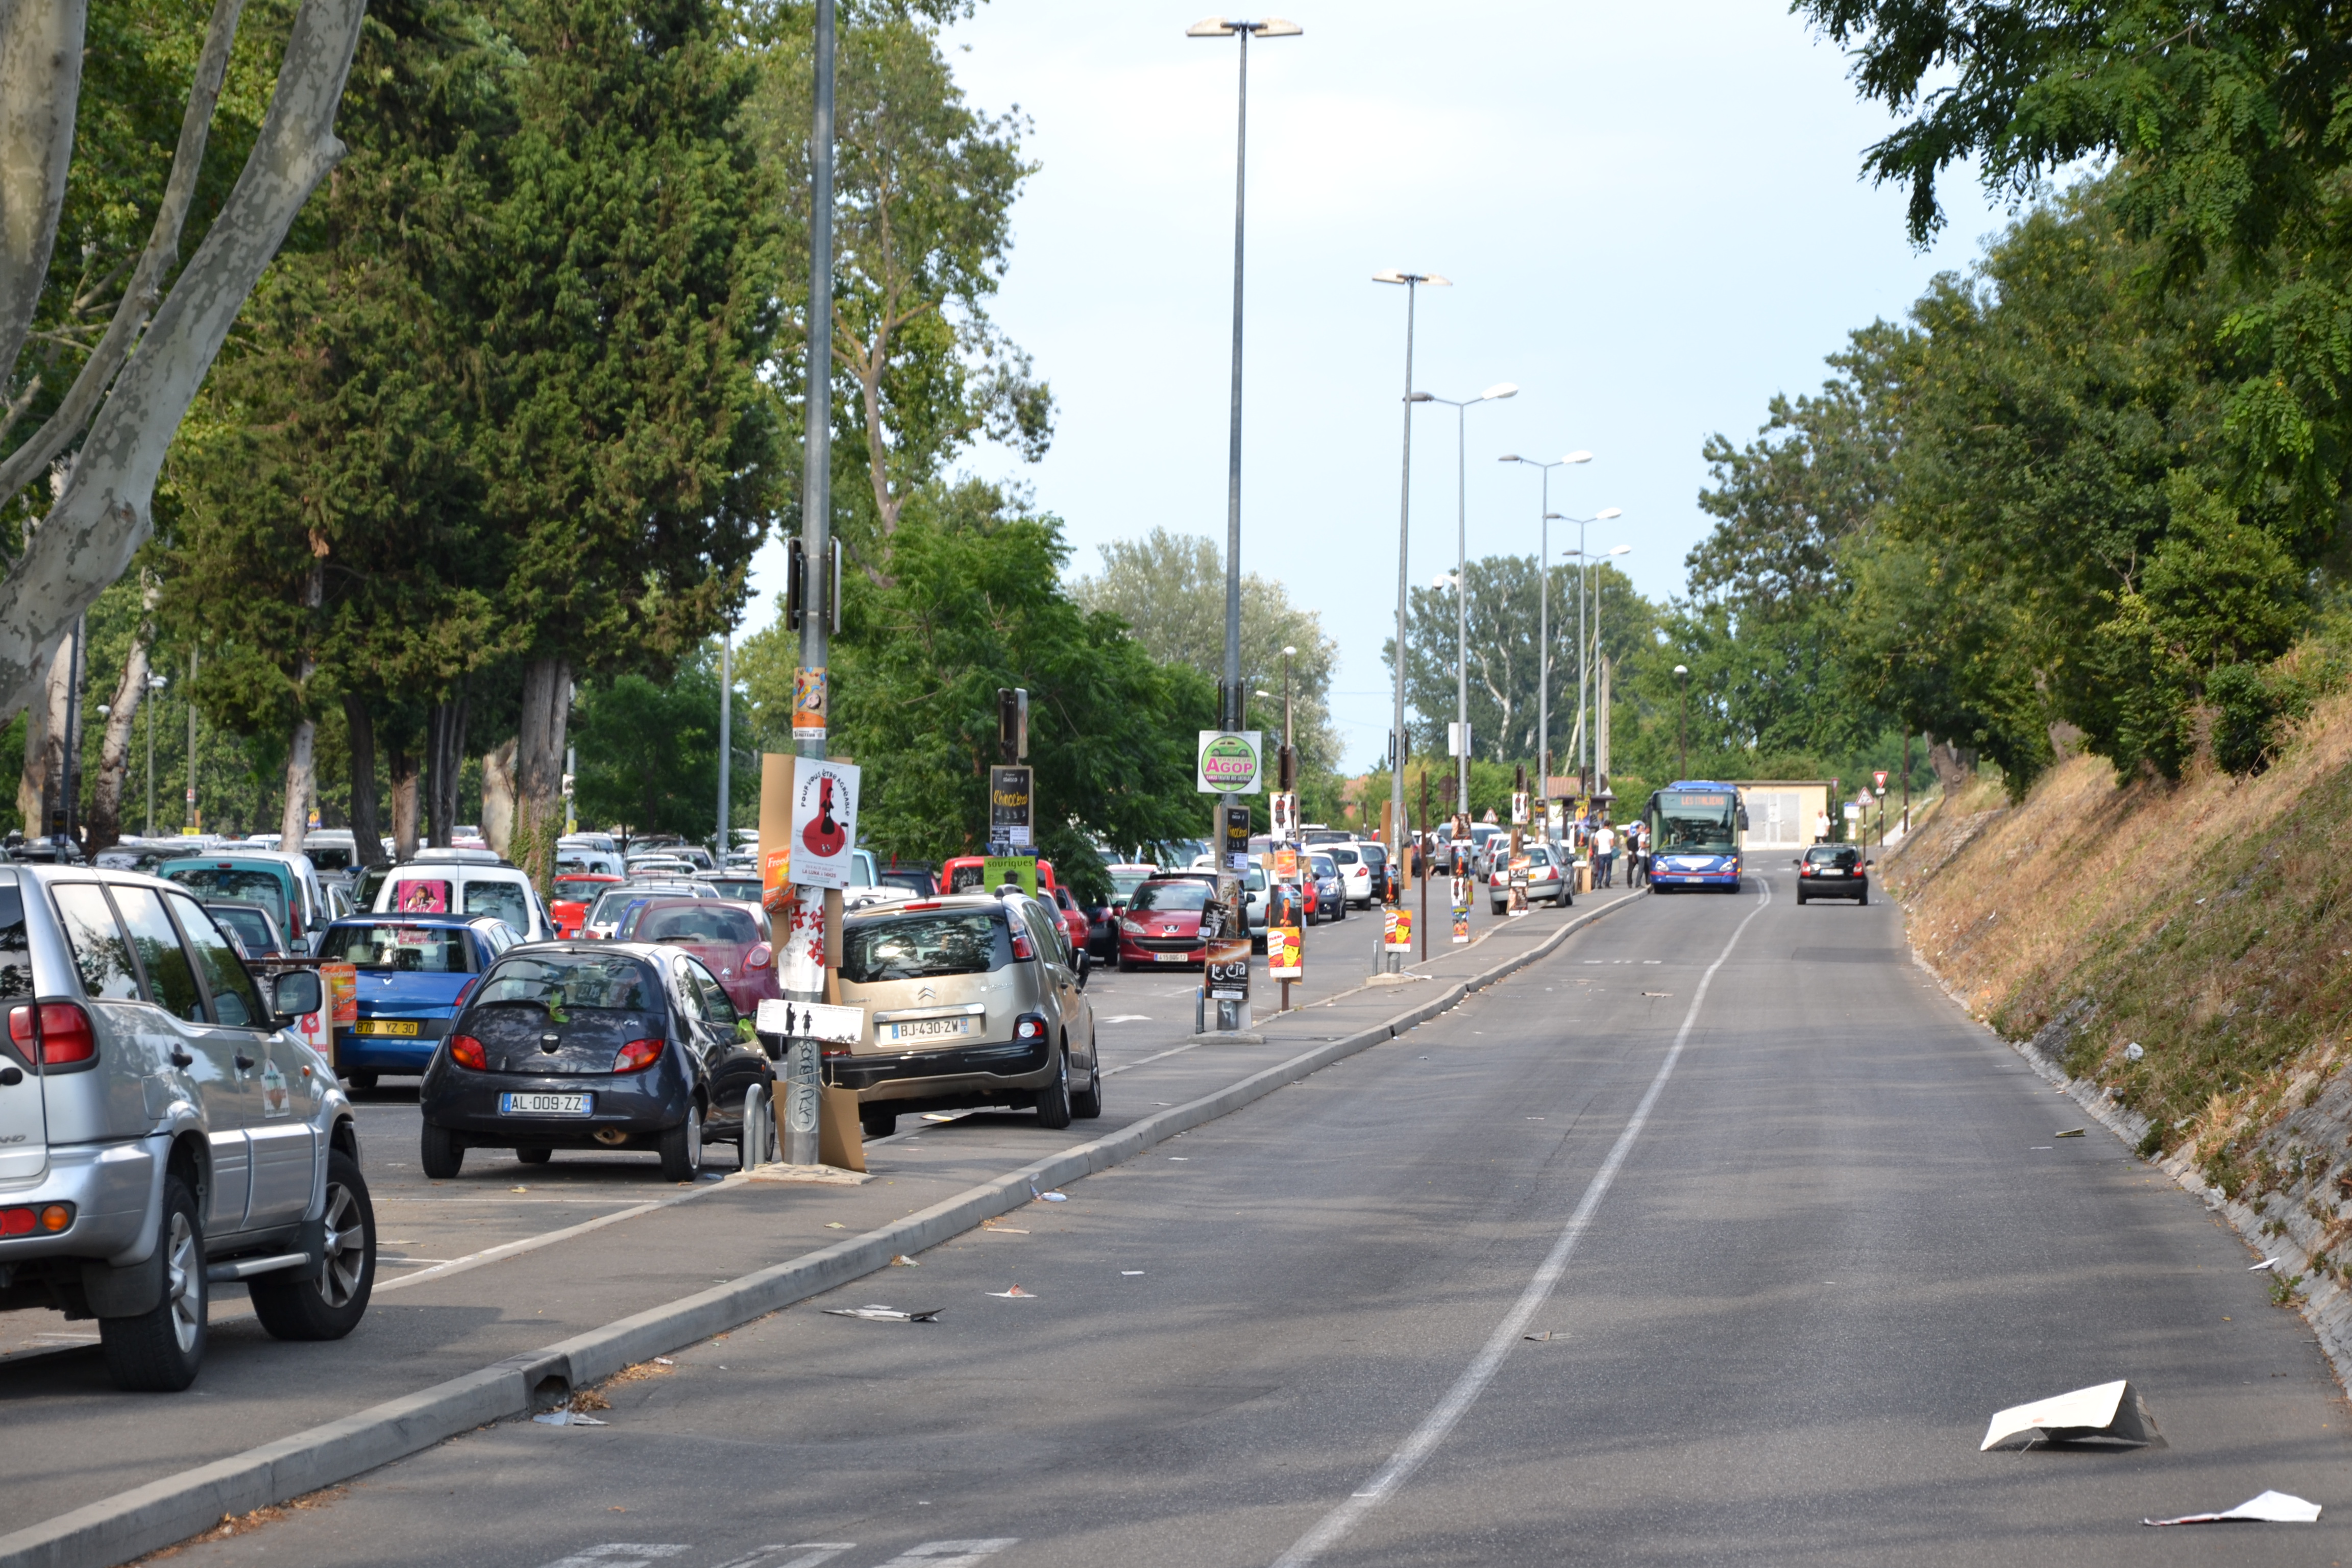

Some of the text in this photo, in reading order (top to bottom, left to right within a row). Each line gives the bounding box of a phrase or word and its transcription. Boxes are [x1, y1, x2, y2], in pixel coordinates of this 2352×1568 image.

[1205, 757, 1253, 773] AGOP
[1211, 961, 1245, 981] Le Cid
[357, 1022, 414, 1034] 870 YZ 30
[901, 1020, 958, 1037] BJ-430-ZW
[511, 1096, 581, 1111] AL-009-ZZ
